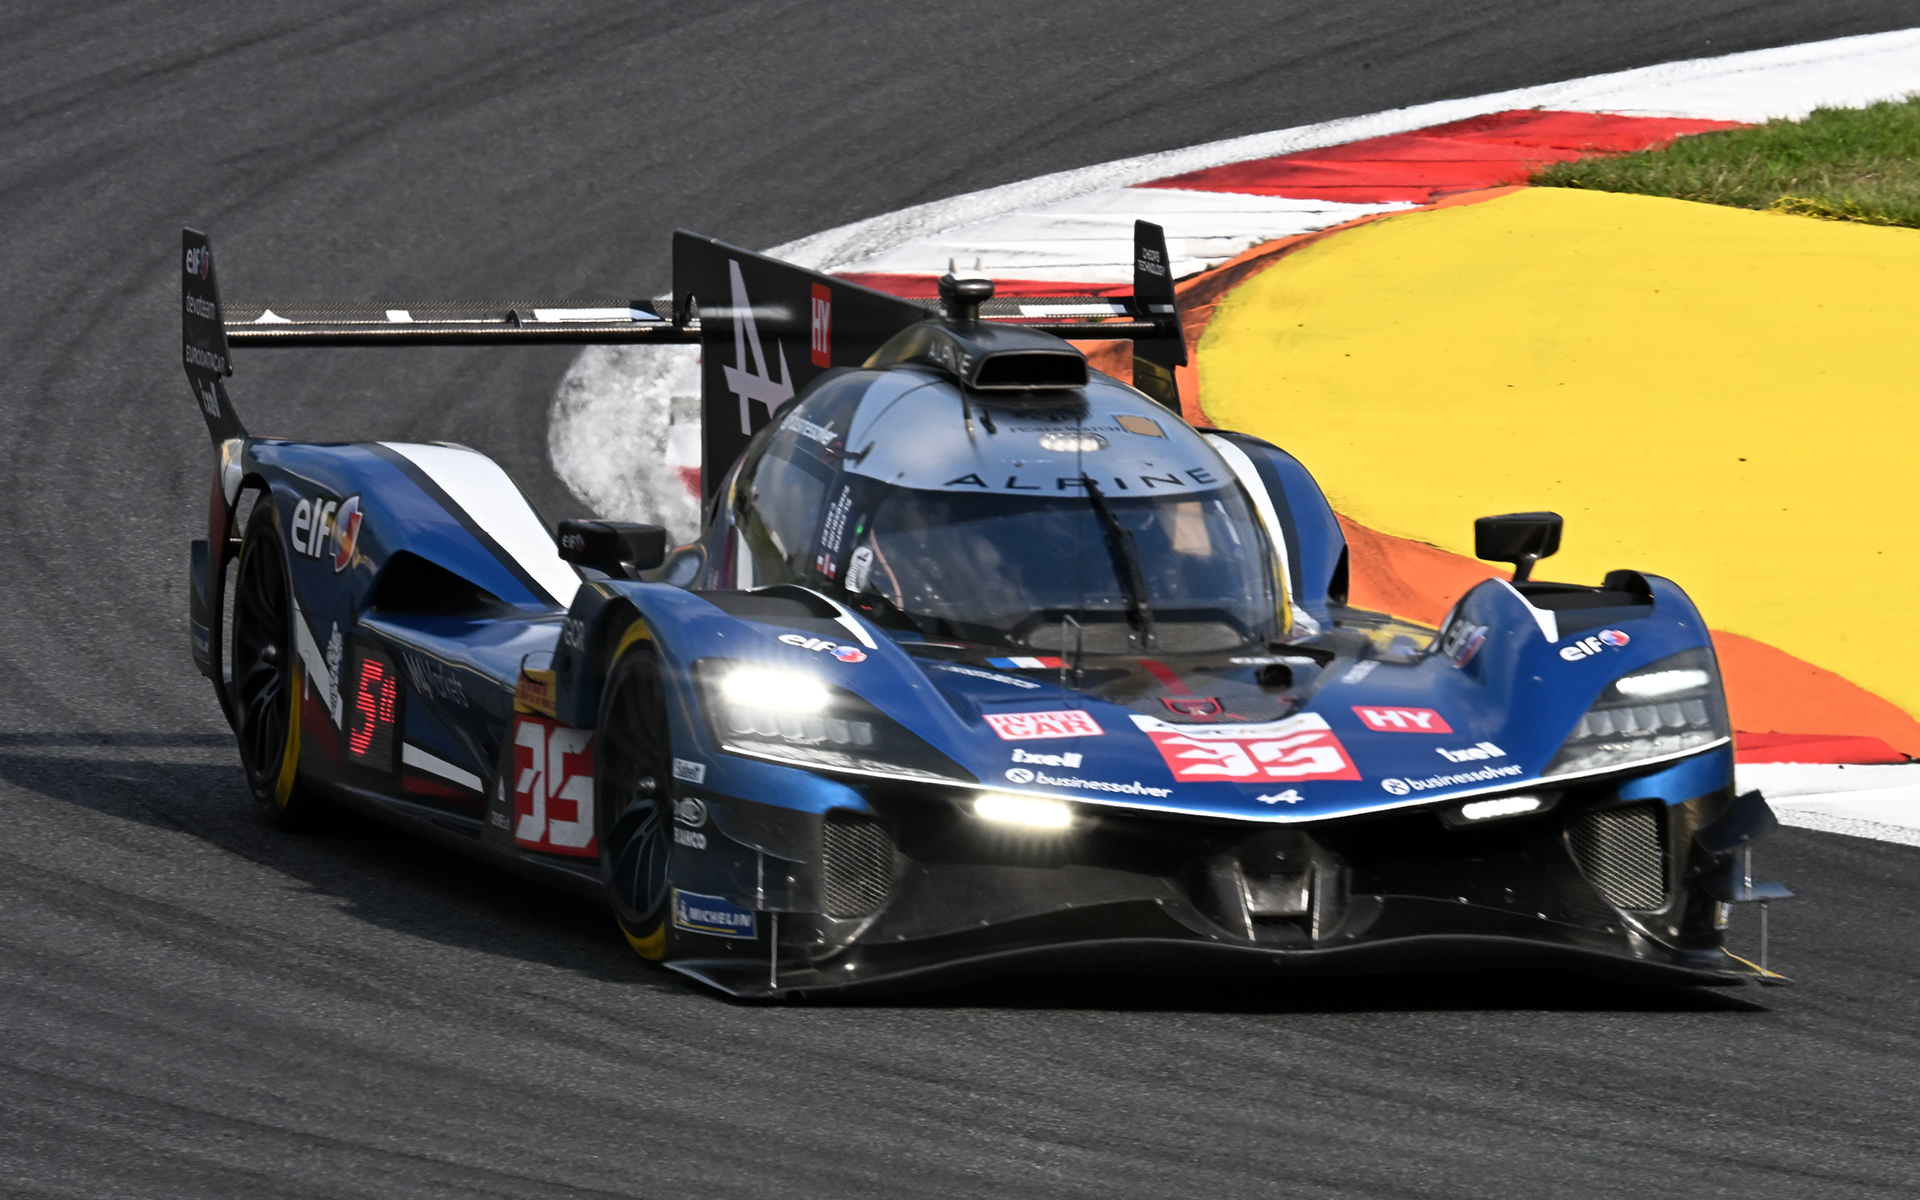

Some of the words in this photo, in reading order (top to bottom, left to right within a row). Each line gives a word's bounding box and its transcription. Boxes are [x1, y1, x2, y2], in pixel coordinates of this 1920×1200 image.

[186, 247, 201, 275] elf
[186, 291, 216, 321] devoteam
[811, 297, 830, 354] HY
[927, 340, 973, 376] ALPINE
[944, 467, 1219, 491] ALPINE
[291, 496, 337, 559] elf
[561, 534, 576, 550] elf
[779, 633, 838, 653] elf
[1559, 636, 1603, 661] elf
[1001, 720, 1094, 736] CAR
[1363, 709, 1434, 728] HY
[1160, 731, 1347, 778] 35
[514, 720, 596, 849] 35
[1035, 771, 1173, 798] businessolver
[1404, 764, 1523, 791] businessolver
[689, 907, 751, 927] MICHELIN
